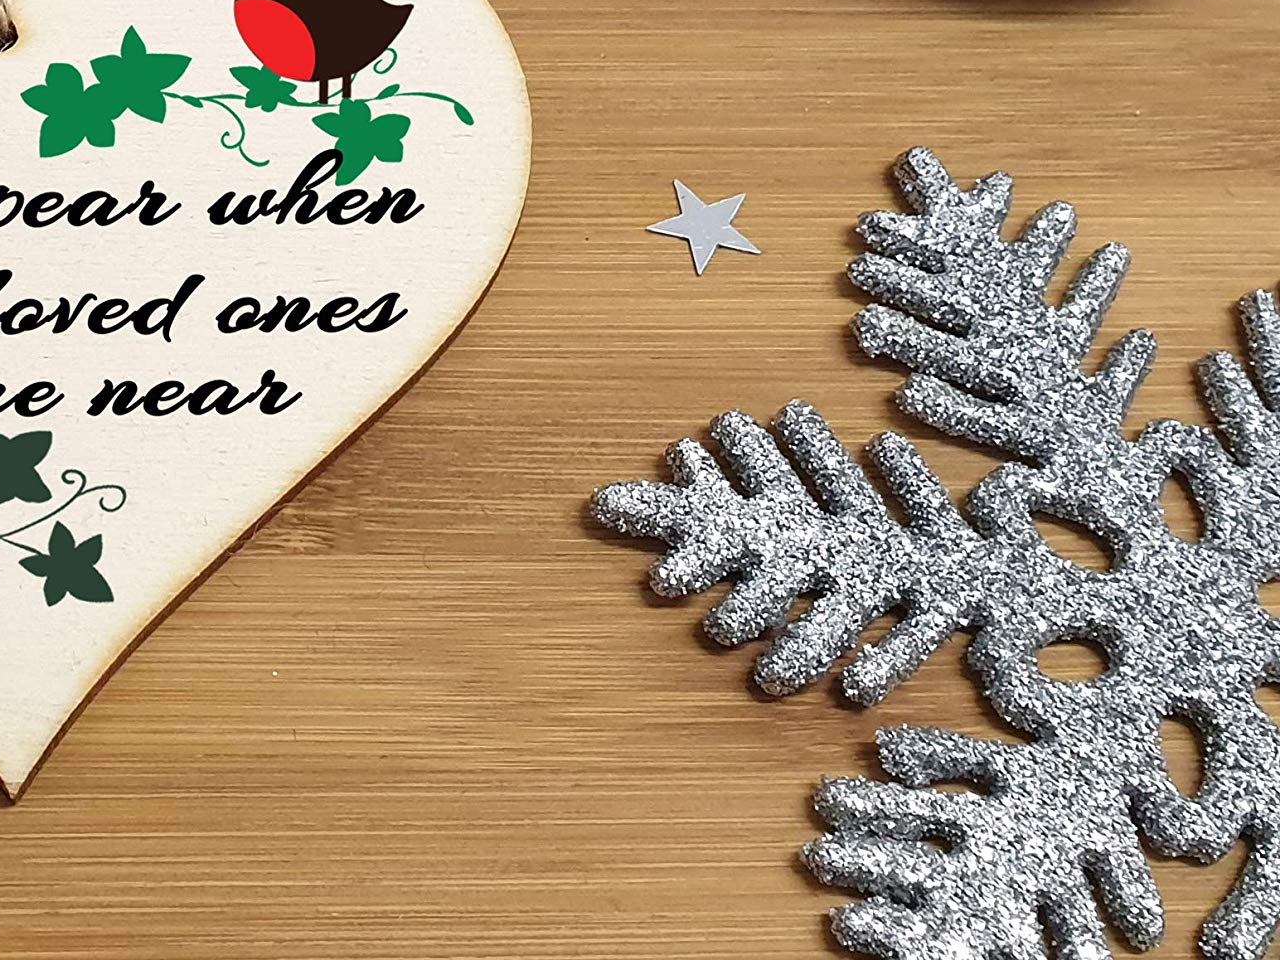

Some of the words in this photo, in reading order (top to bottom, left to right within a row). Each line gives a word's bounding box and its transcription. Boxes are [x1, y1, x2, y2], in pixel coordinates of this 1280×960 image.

[207, 148, 425, 225] when
[215, 292, 409, 334] ones
[86, 370, 303, 417] near
